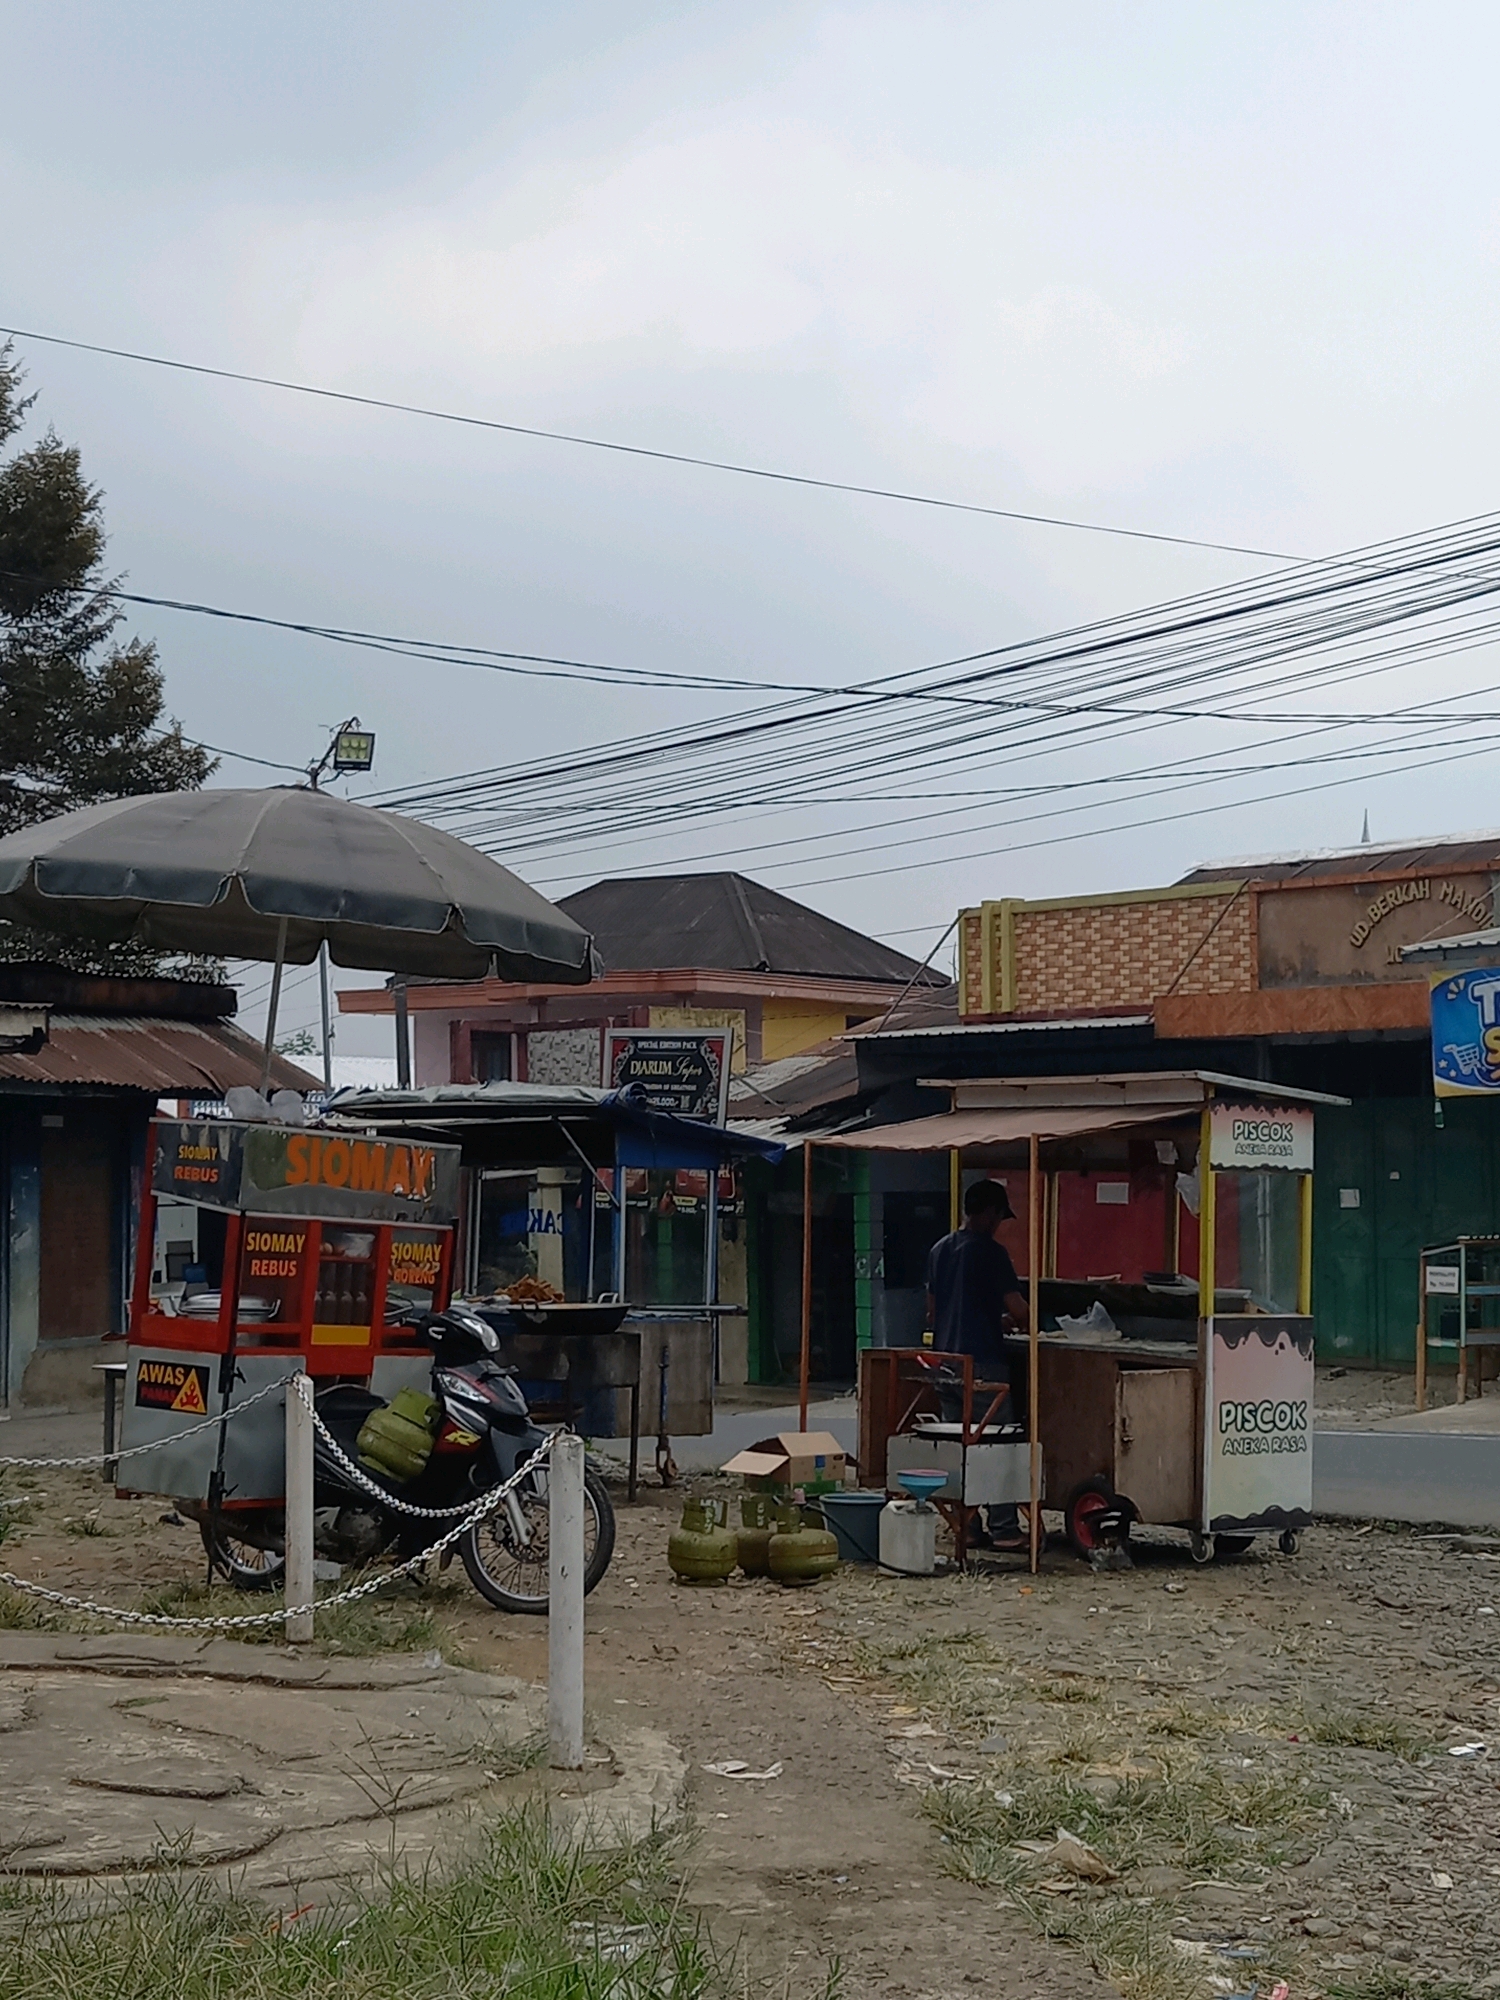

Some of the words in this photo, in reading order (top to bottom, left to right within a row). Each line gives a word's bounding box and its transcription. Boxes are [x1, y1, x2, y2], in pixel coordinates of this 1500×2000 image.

[682, 1041, 697, 1050] PACK
[630, 1060, 673, 1076] DJARUM
[1233, 1119, 1293, 1142] PISCOK
[178, 1144, 218, 1161] SIOMAY
[1235, 1142, 1267, 1156] ANEKA
[1268, 1144, 1293, 1157] RASA
[174, 1165, 219, 1183] REBUS
[285, 1135, 436, 1196] SIOMAY
[246, 1232, 305, 1253] SIOMAY
[390, 1242, 442, 1261] SIOMAY
[250, 1258, 297, 1277] REBUS
[393, 1268, 436, 1285] GORENG
[138, 1363, 185, 1386] AWAS
[1220, 1399, 1307, 1433] PISCOK
[1222, 1437, 1270, 1456] ANEKA
[1271, 1435, 1307, 1454] RASA
